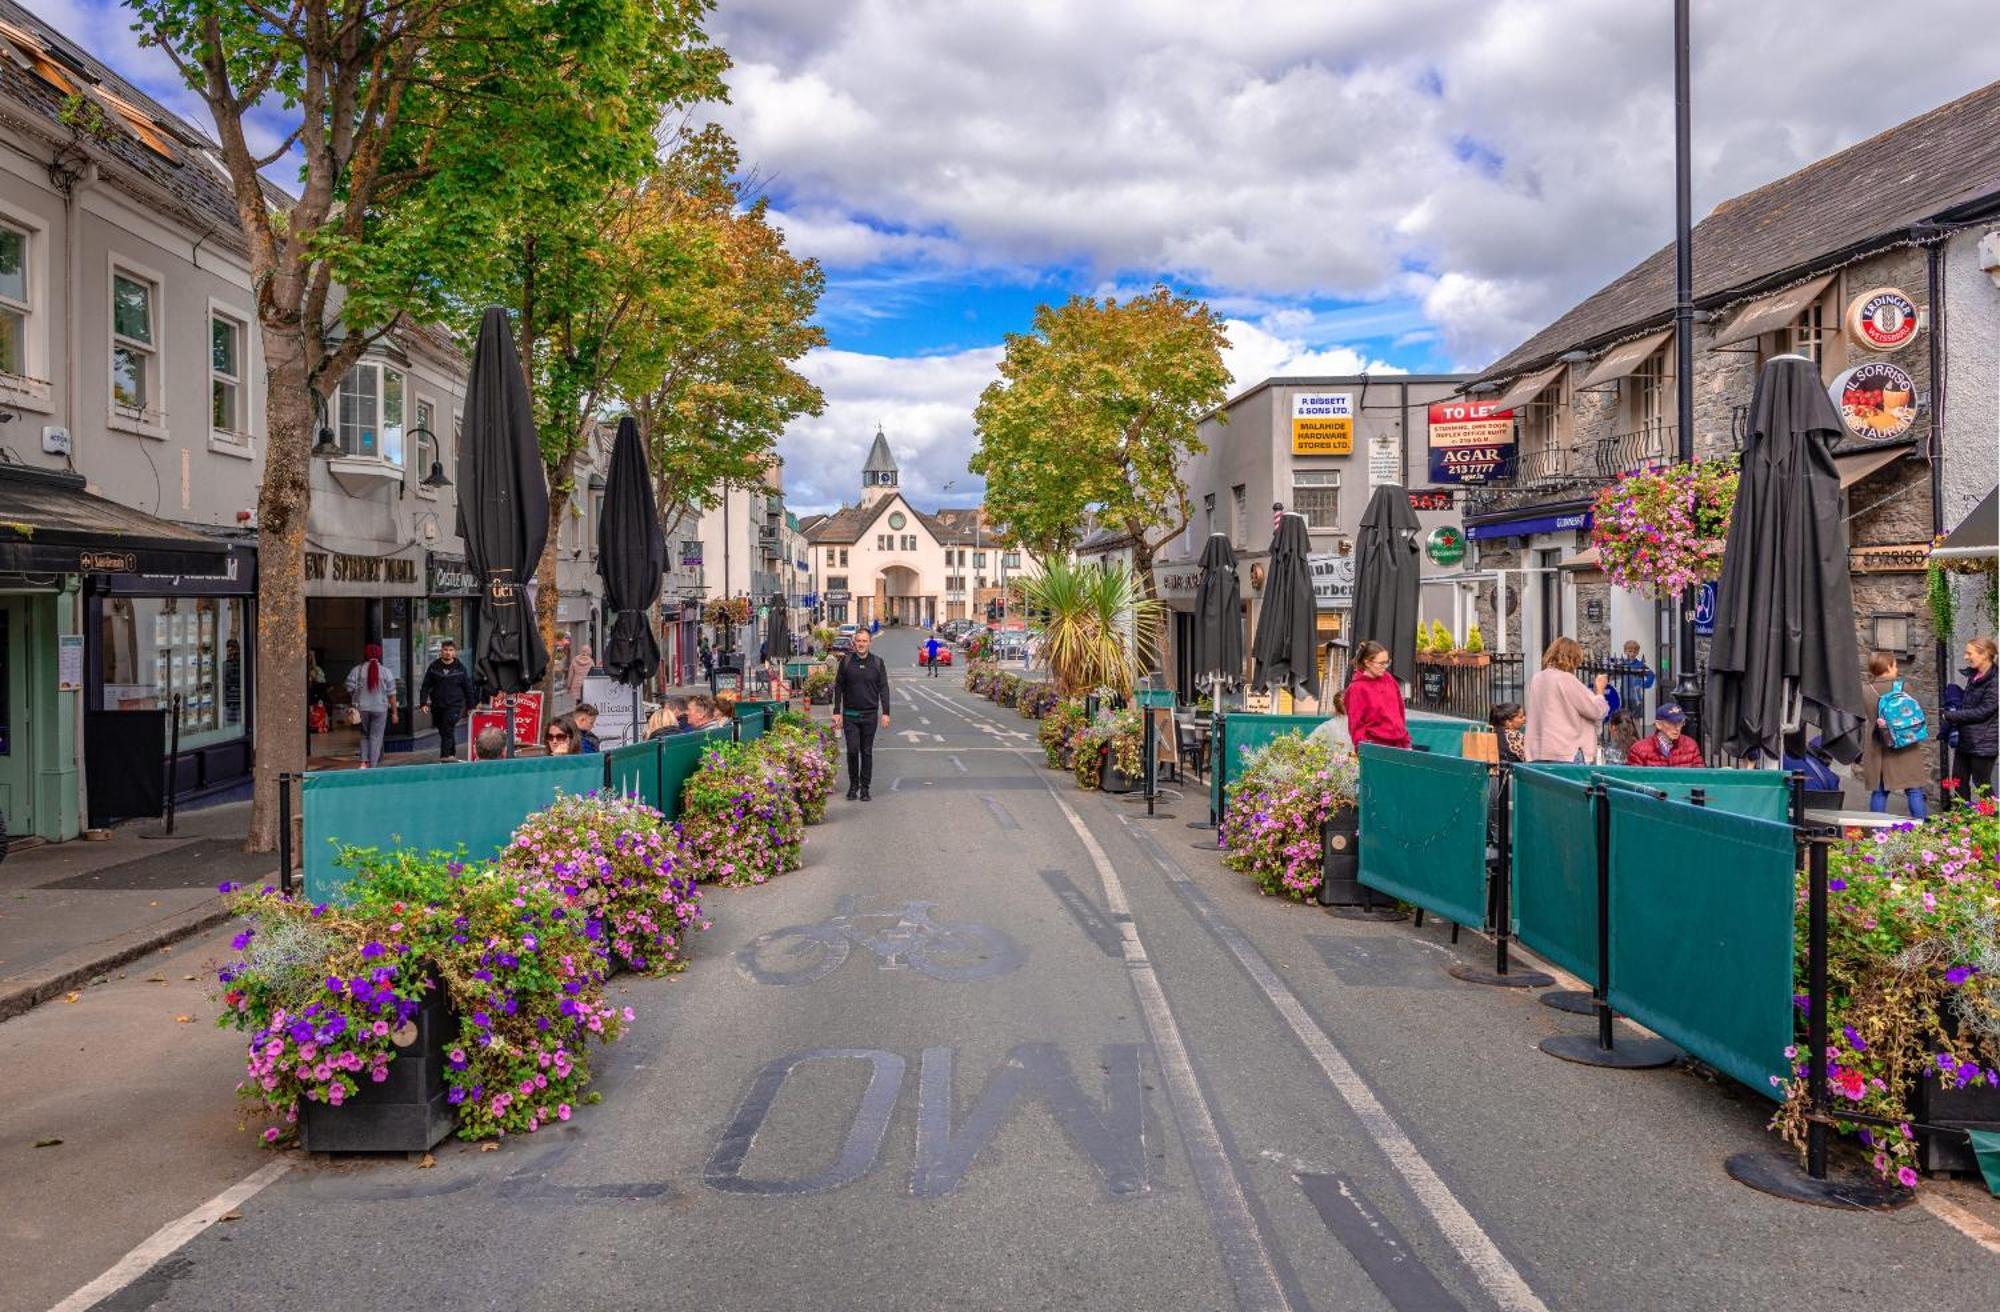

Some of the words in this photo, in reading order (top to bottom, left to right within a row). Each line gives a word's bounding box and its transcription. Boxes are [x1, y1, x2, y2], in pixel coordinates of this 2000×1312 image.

[1864, 295, 1911, 316] ERDINGER
[1846, 380, 1860, 392] IL
[1857, 365, 1911, 392] SORRISO
[1332, 407, 1350, 415] LTD.
[1443, 407, 1465, 419] TO
[1298, 432, 1347, 440] HARDWARE
[1298, 441, 1331, 449] STORES
[1332, 441, 1350, 449] LTD.
[1443, 449, 1502, 462] AGAR
[304, 552, 328, 580] EW
